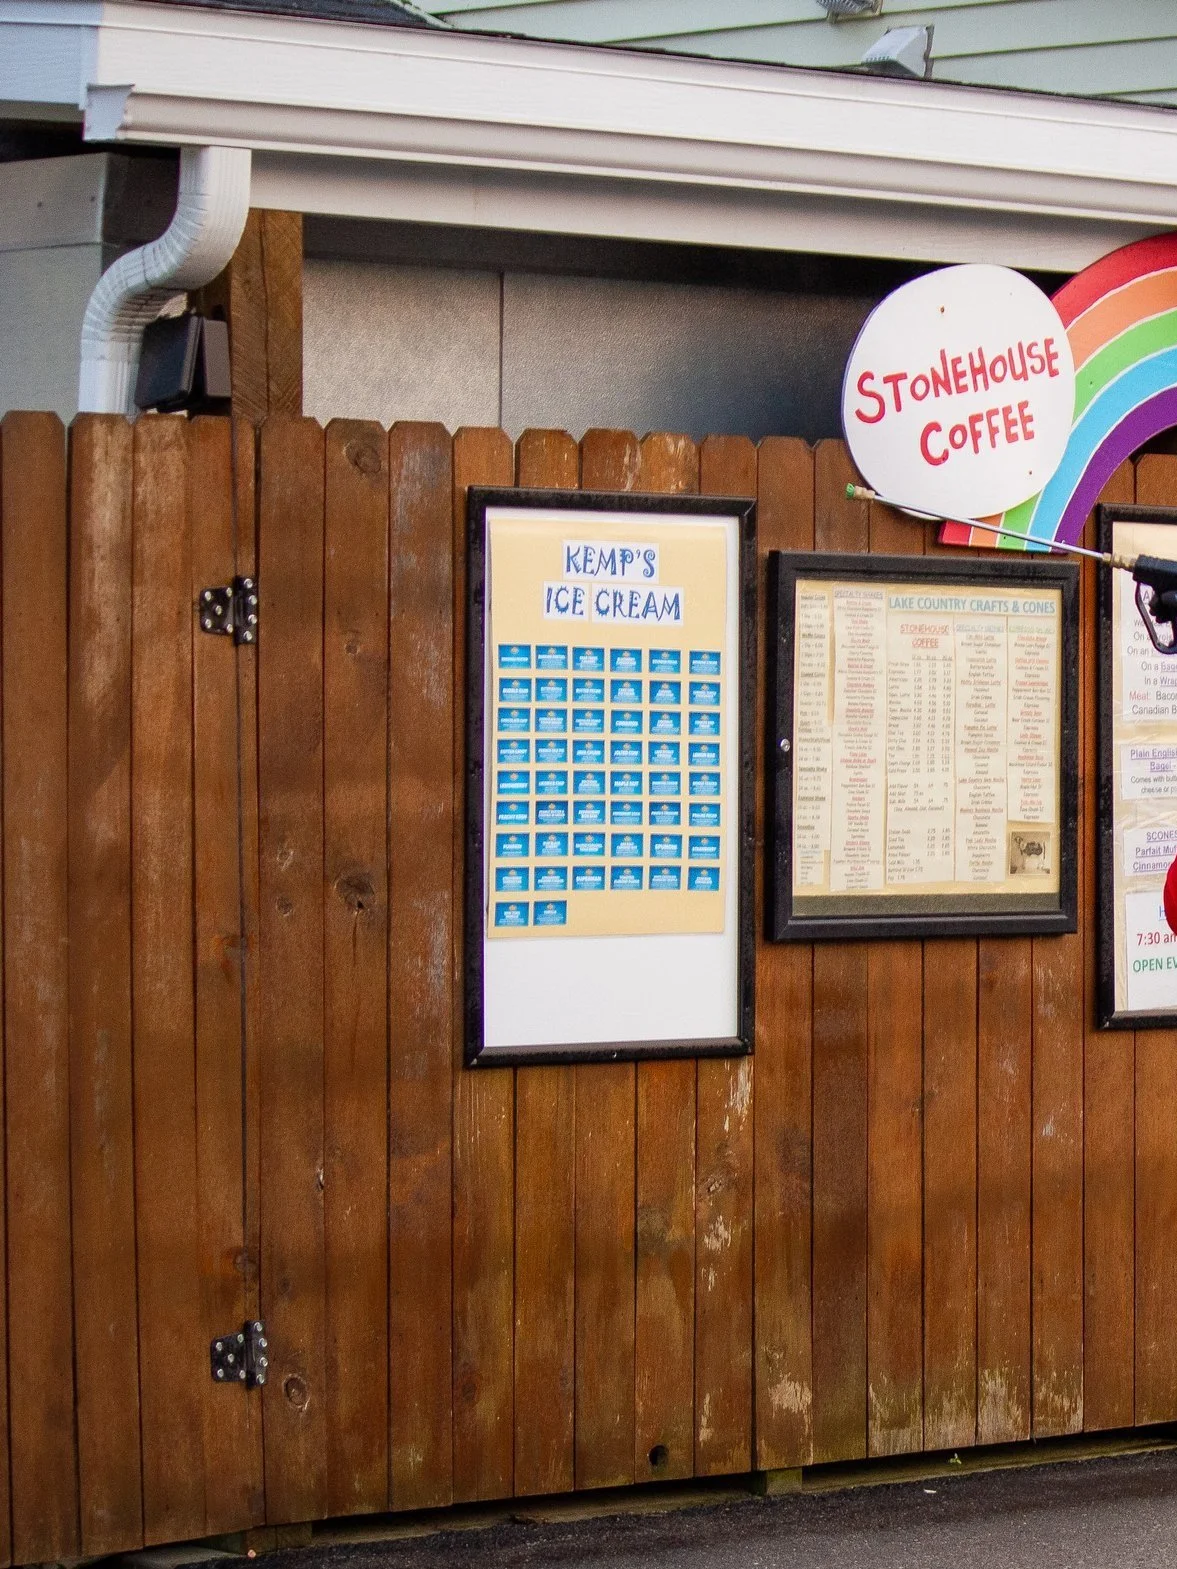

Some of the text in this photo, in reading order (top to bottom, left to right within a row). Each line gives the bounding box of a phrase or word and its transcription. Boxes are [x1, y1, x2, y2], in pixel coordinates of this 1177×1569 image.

[855, 338, 1059, 424] STONEHOUSE
[920, 400, 1035, 466] COFFEE
[566, 545, 656, 578] KEMP'S
[546, 585, 680, 621] ICE CREAM
[889, 597, 1055, 614] LAKE COUNTRY CRAFTS & CONES
[900, 624, 949, 634] STONEHOUSE
[1134, 631, 1144, 640] On
[912, 638, 939, 648] COFFEE
[1127, 646, 1138, 655] On
[1141, 662, 1152, 671] On
[1144, 677, 1151, 685] In
[1132, 705, 1169, 715] Canadian
[1131, 749, 1149, 758] Plain
[1150, 761, 1171, 771] Bagel
[1136, 846, 1161, 856] Parfait
[1137, 932, 1160, 946] 7:30
[1133, 958, 1162, 973] OPEN
